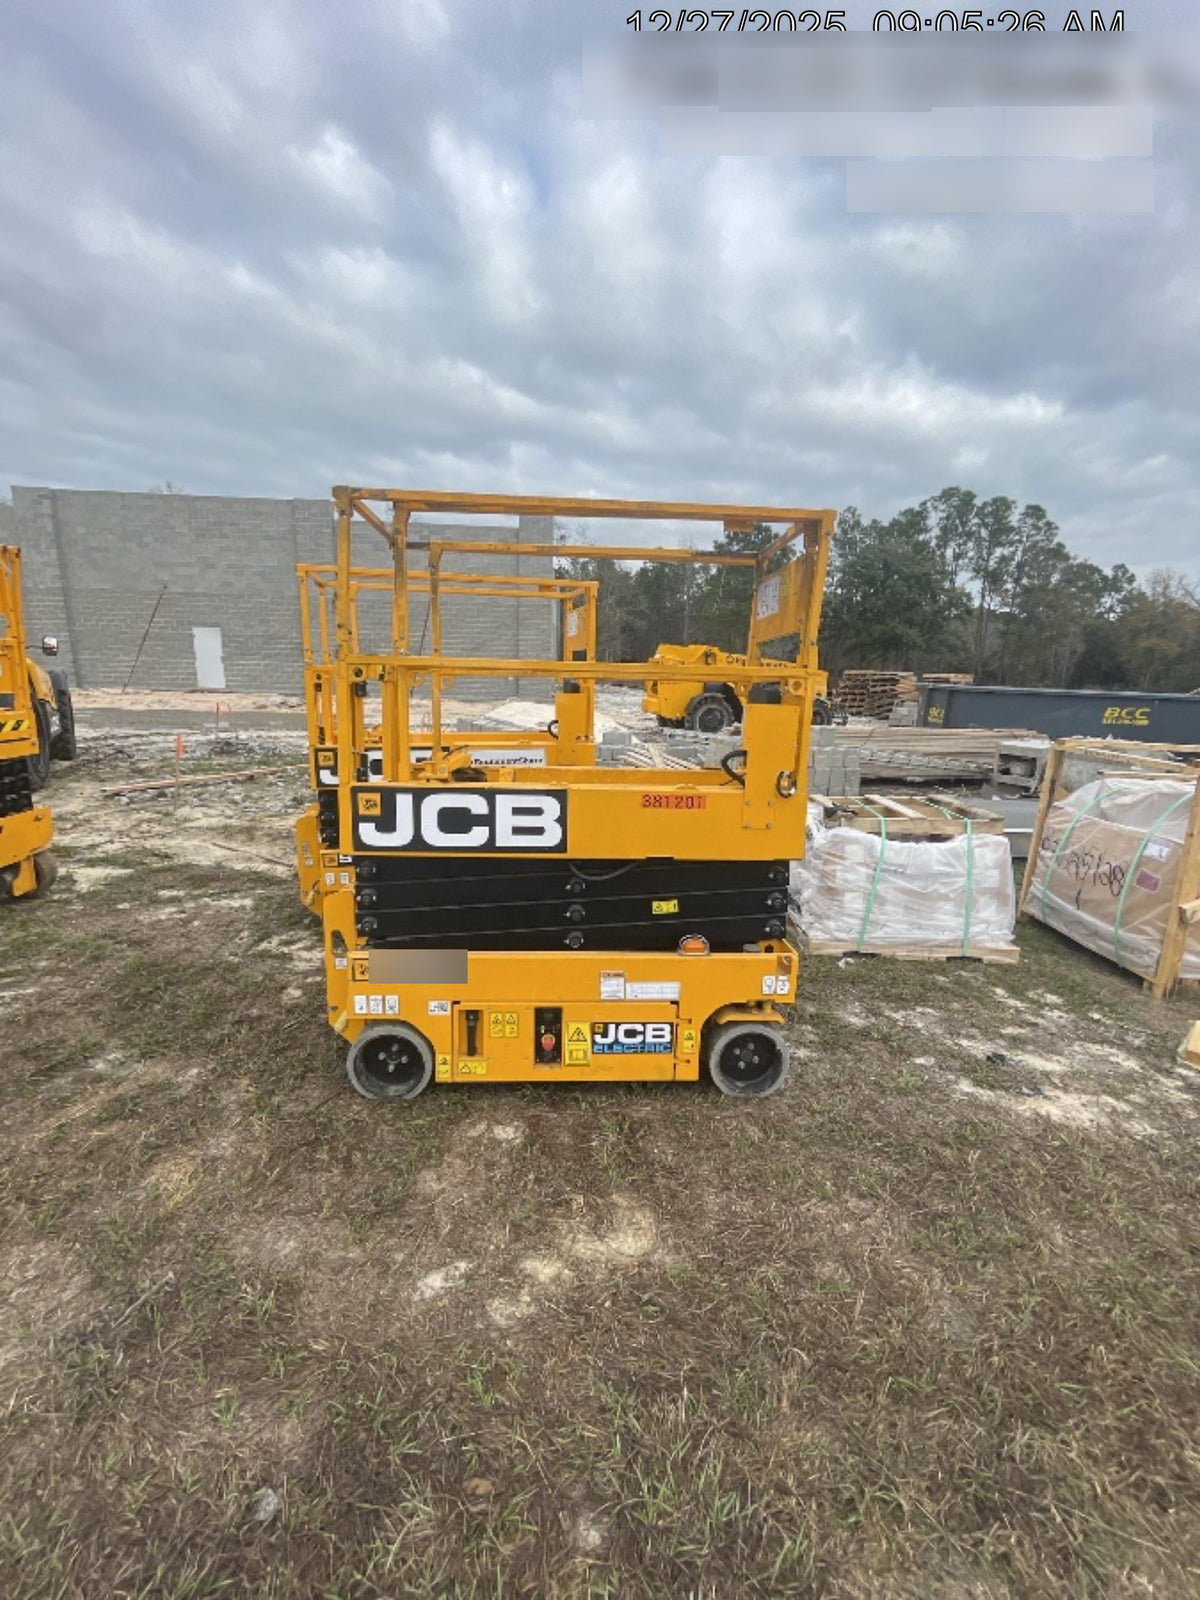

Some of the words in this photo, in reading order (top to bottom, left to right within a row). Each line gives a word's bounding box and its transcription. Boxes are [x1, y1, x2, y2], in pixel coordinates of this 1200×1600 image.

[642, 794, 702, 809] 381201
[358, 792, 563, 847] JCB
[594, 1023, 671, 1044] JCB
